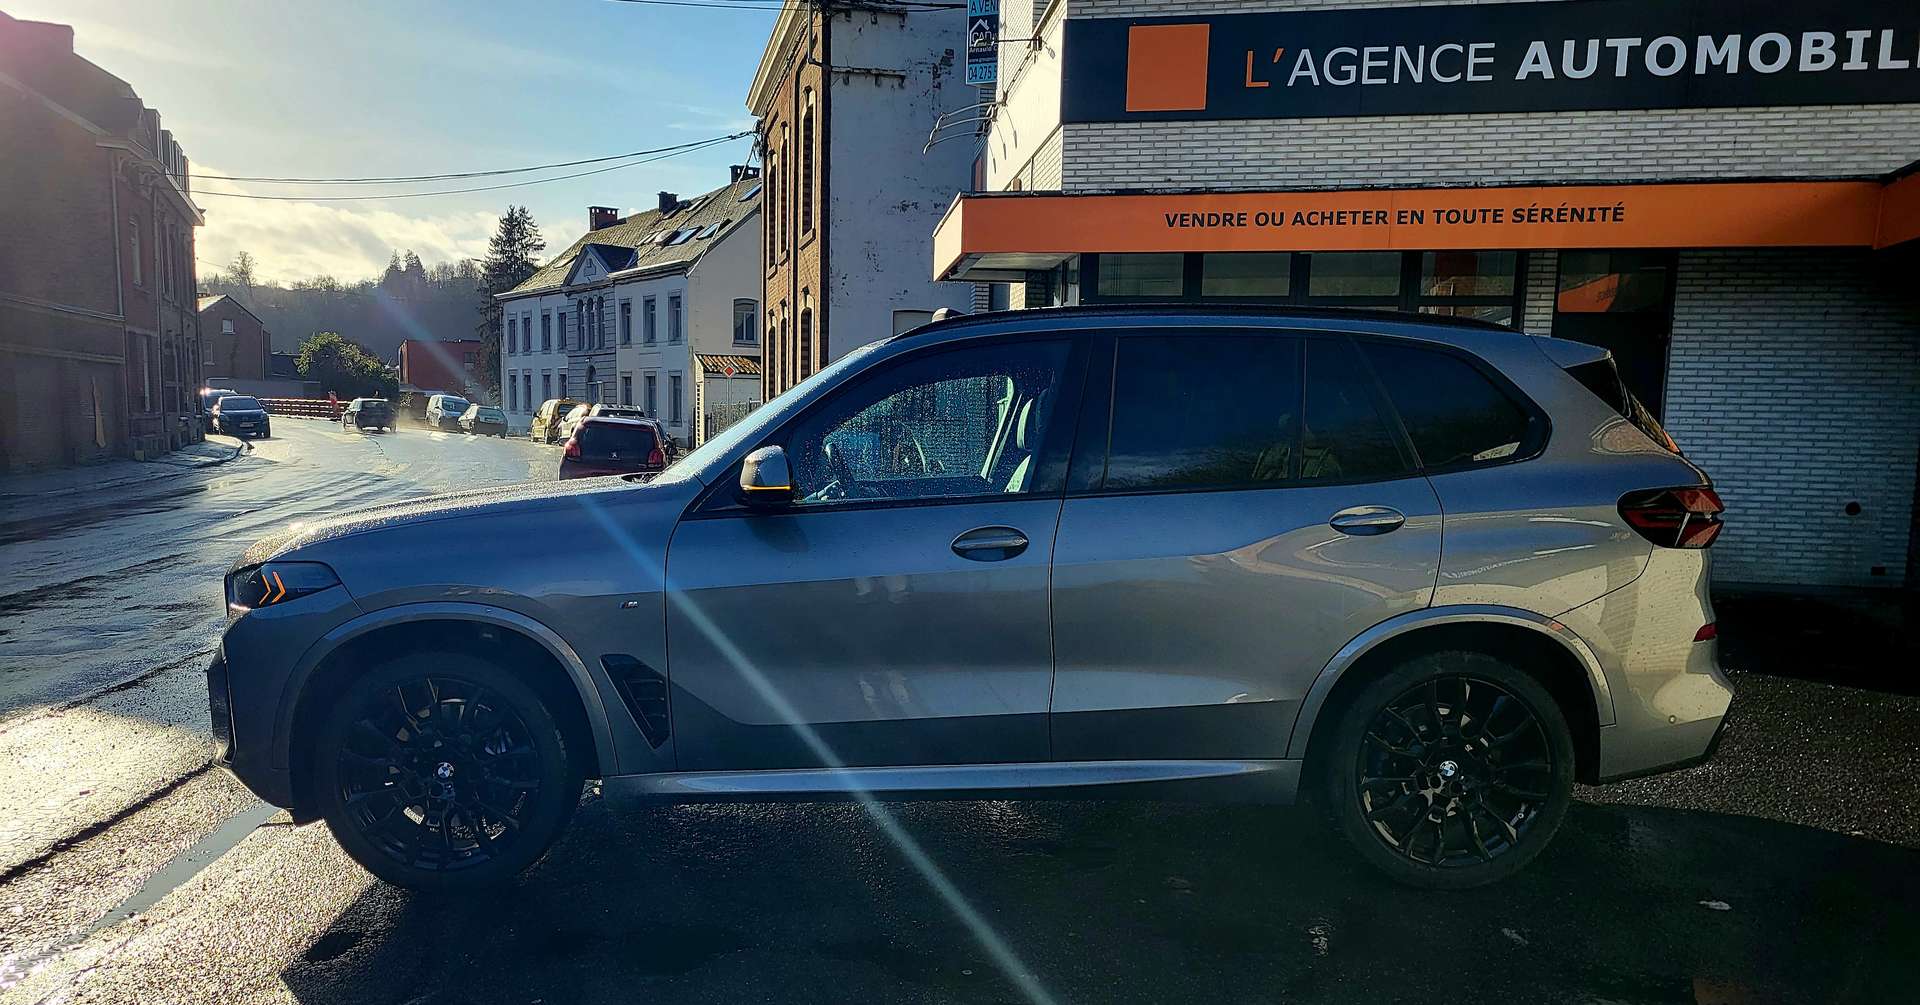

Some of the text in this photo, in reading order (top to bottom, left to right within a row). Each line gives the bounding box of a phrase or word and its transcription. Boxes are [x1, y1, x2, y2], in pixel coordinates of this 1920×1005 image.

[1245, 29, 1920, 88] L'AGENCE AUTOMOBIL
[1164, 201, 1625, 228] VENDRE OU ACHETER EN TOUTE SÉRÉNITÉ
